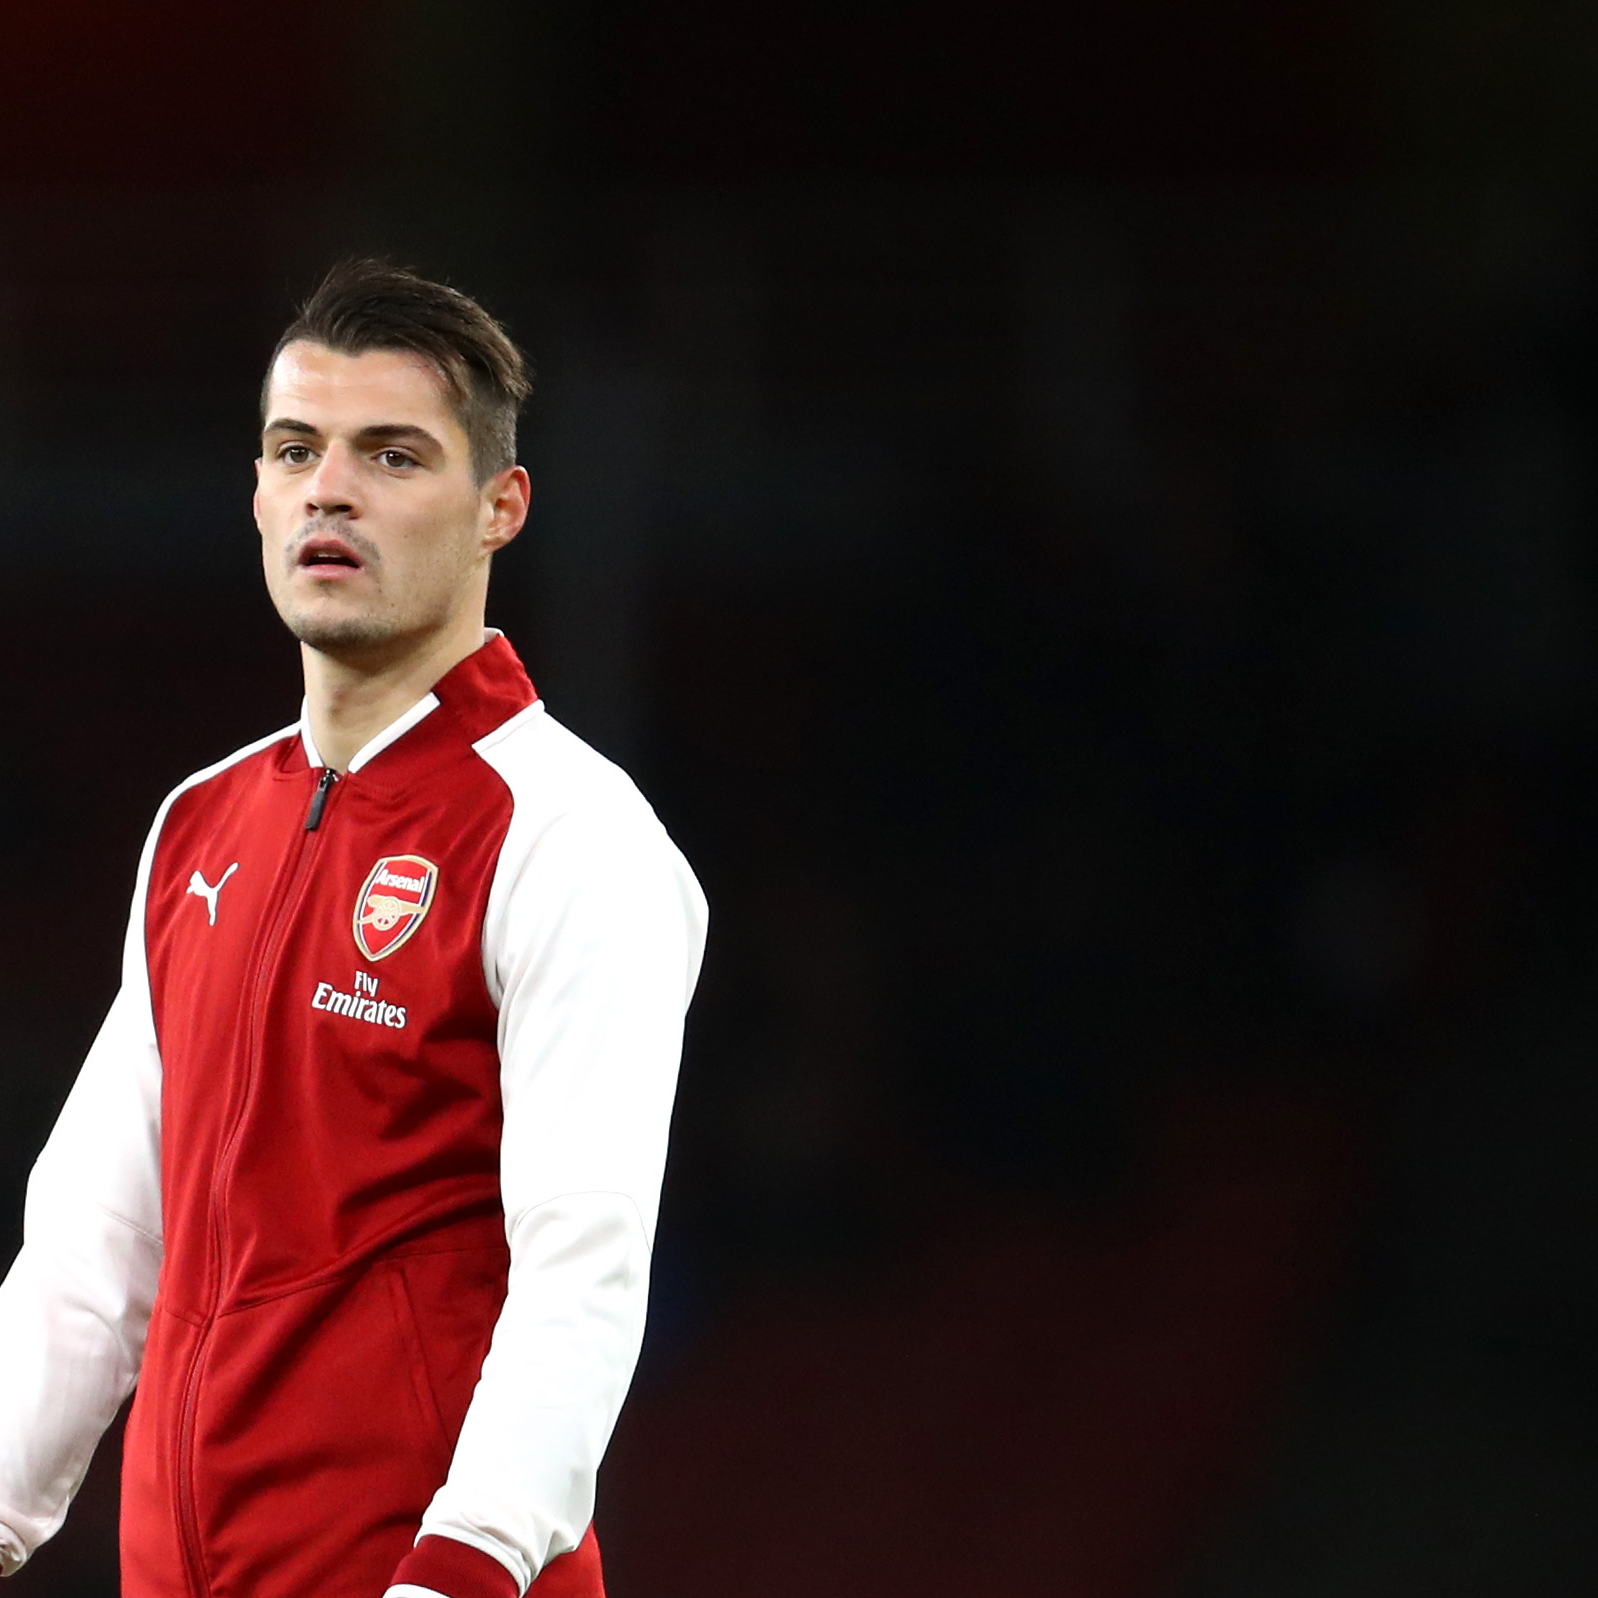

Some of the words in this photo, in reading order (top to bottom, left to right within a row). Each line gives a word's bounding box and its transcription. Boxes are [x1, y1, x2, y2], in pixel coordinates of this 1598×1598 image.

[374, 869, 425, 893] Arsenal
[354, 970, 379, 997] Fly
[311, 982, 407, 1029] Emirates
